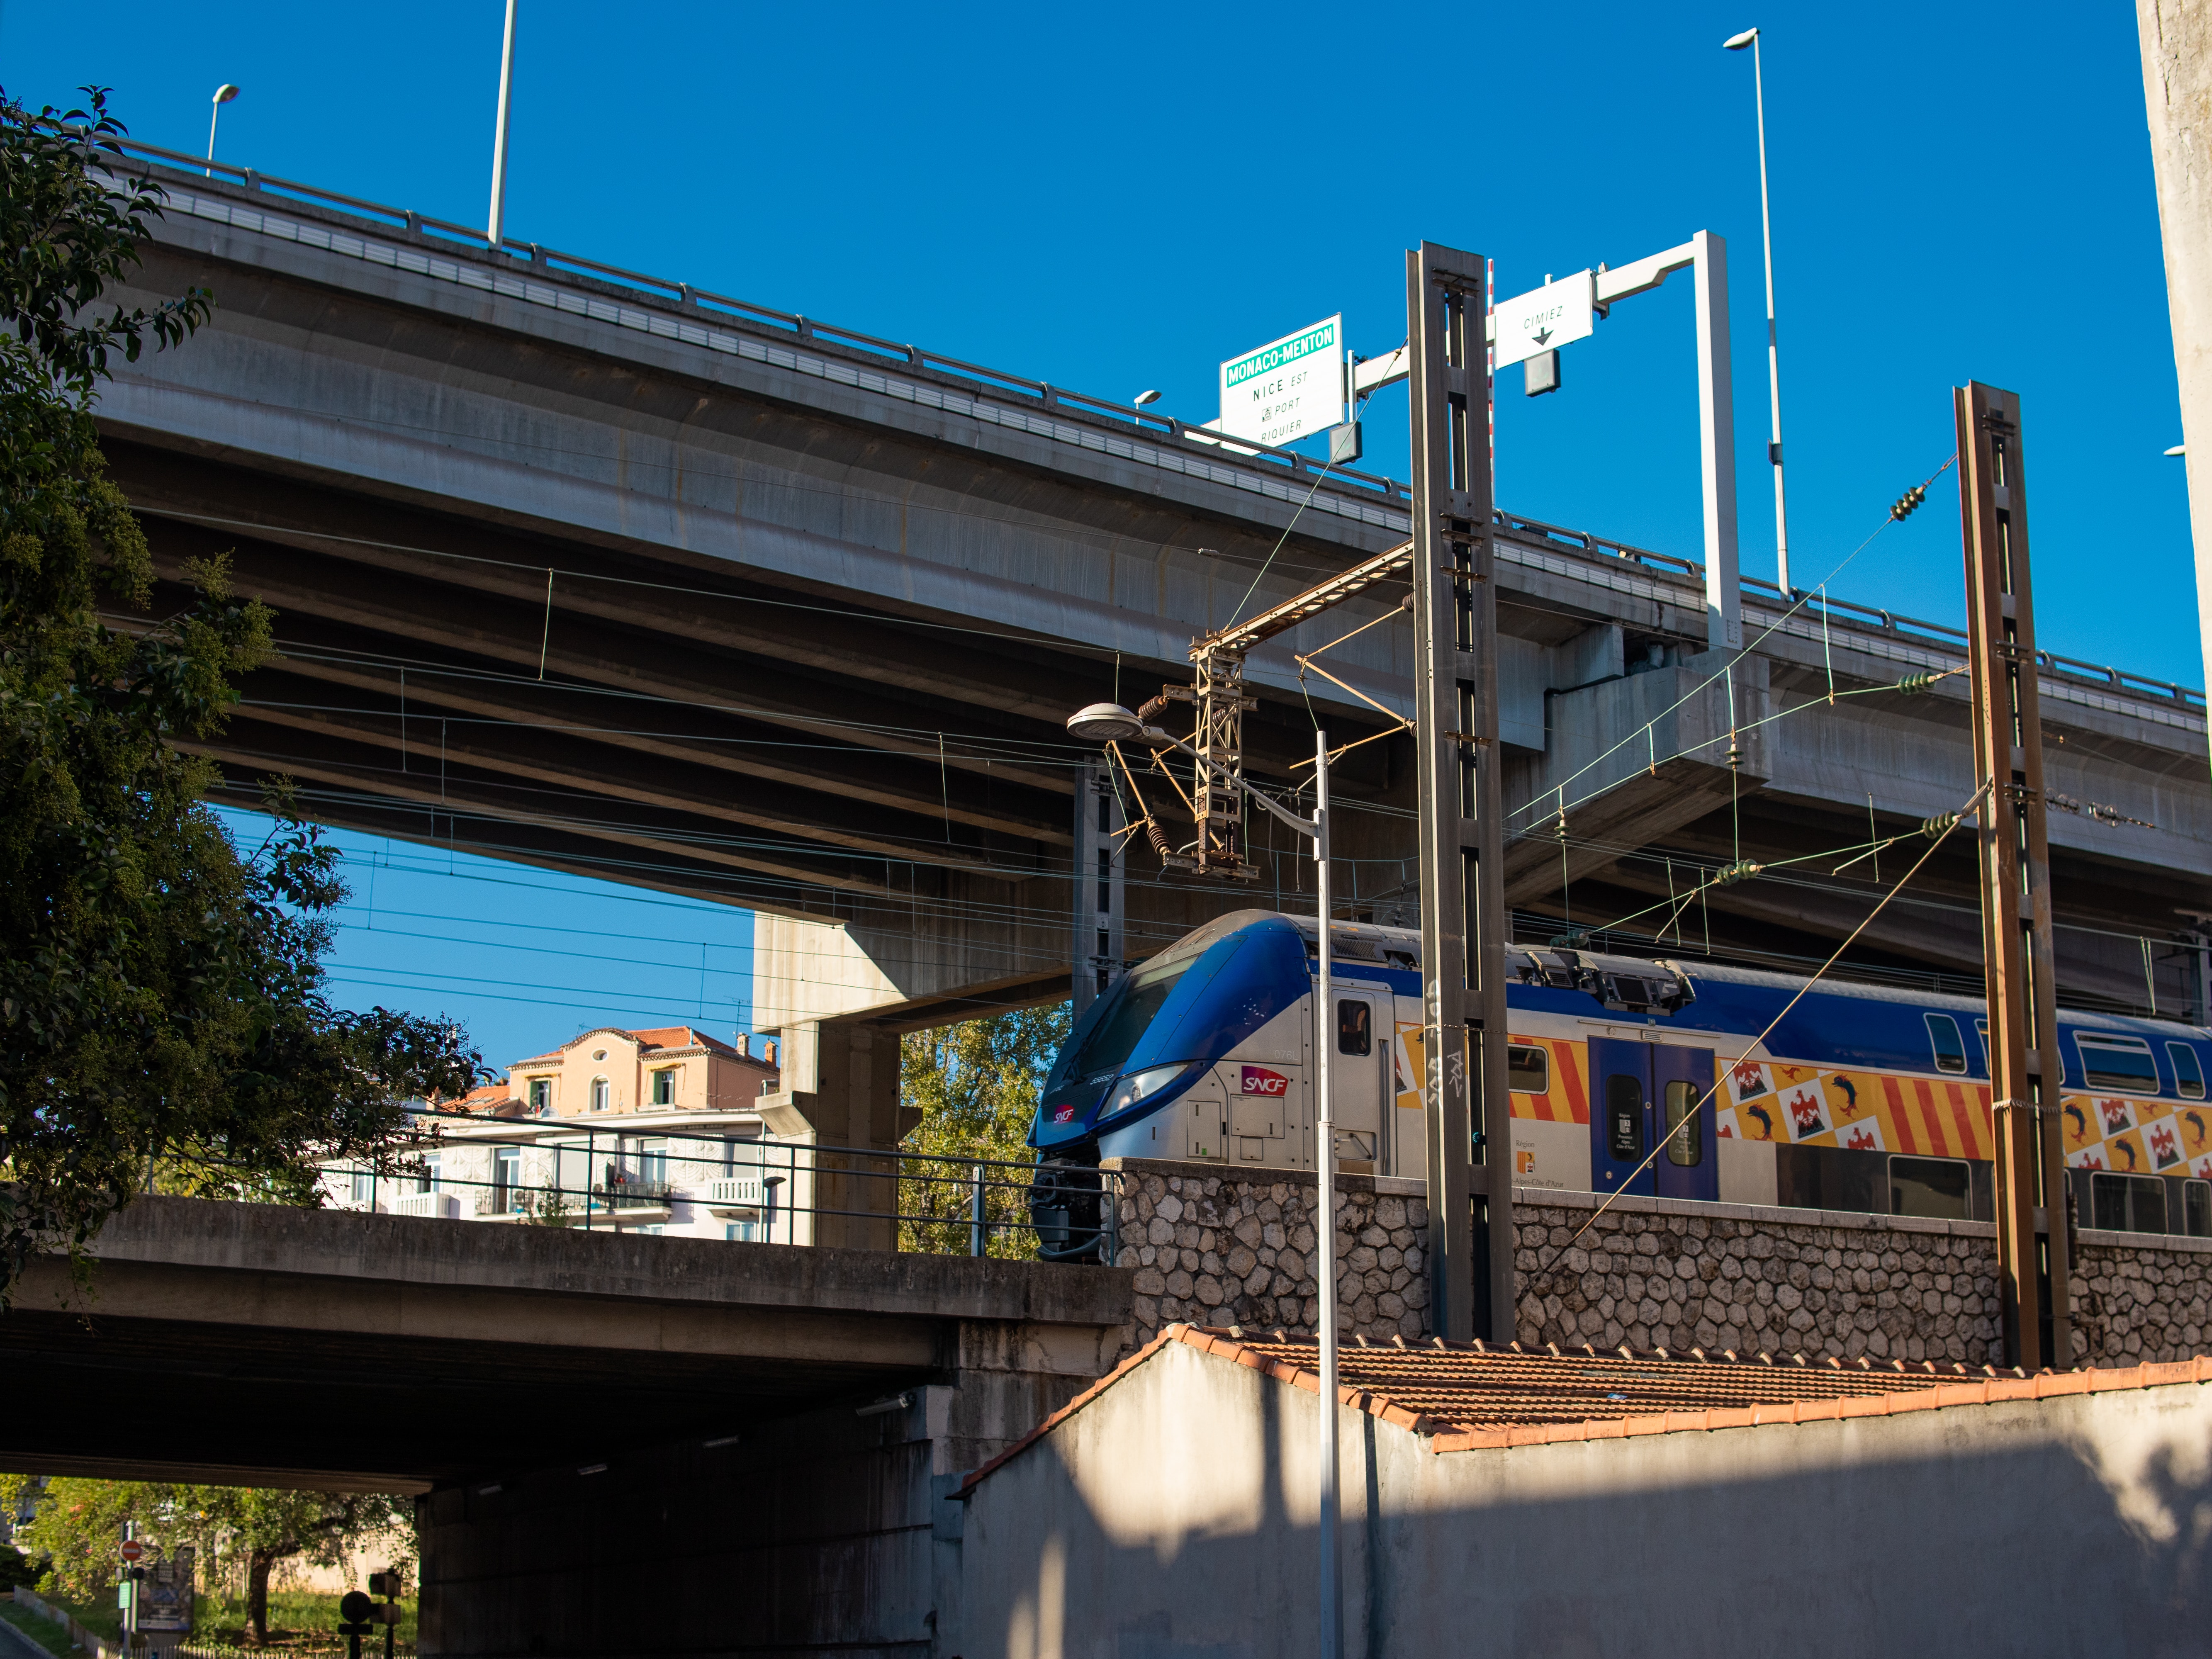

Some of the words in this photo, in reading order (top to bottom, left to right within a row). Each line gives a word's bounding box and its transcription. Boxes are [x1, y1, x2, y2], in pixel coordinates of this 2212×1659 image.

[1524, 306, 1563, 329] CIMIEZ
[1228, 326, 1332, 385] MONACO-MENTON
[1253, 379, 1283, 401] NICE
[1291, 371, 1308, 387] EST
[1275, 397, 1300, 416] PORT
[1261, 419, 1301, 443] RIQUIER
[1274, 1050, 1298, 1060] 076L
[1243, 1077, 1285, 1092] SNCF
[1054, 1109, 1073, 1124] SNCF
[1516, 1140, 1535, 1149] Région
